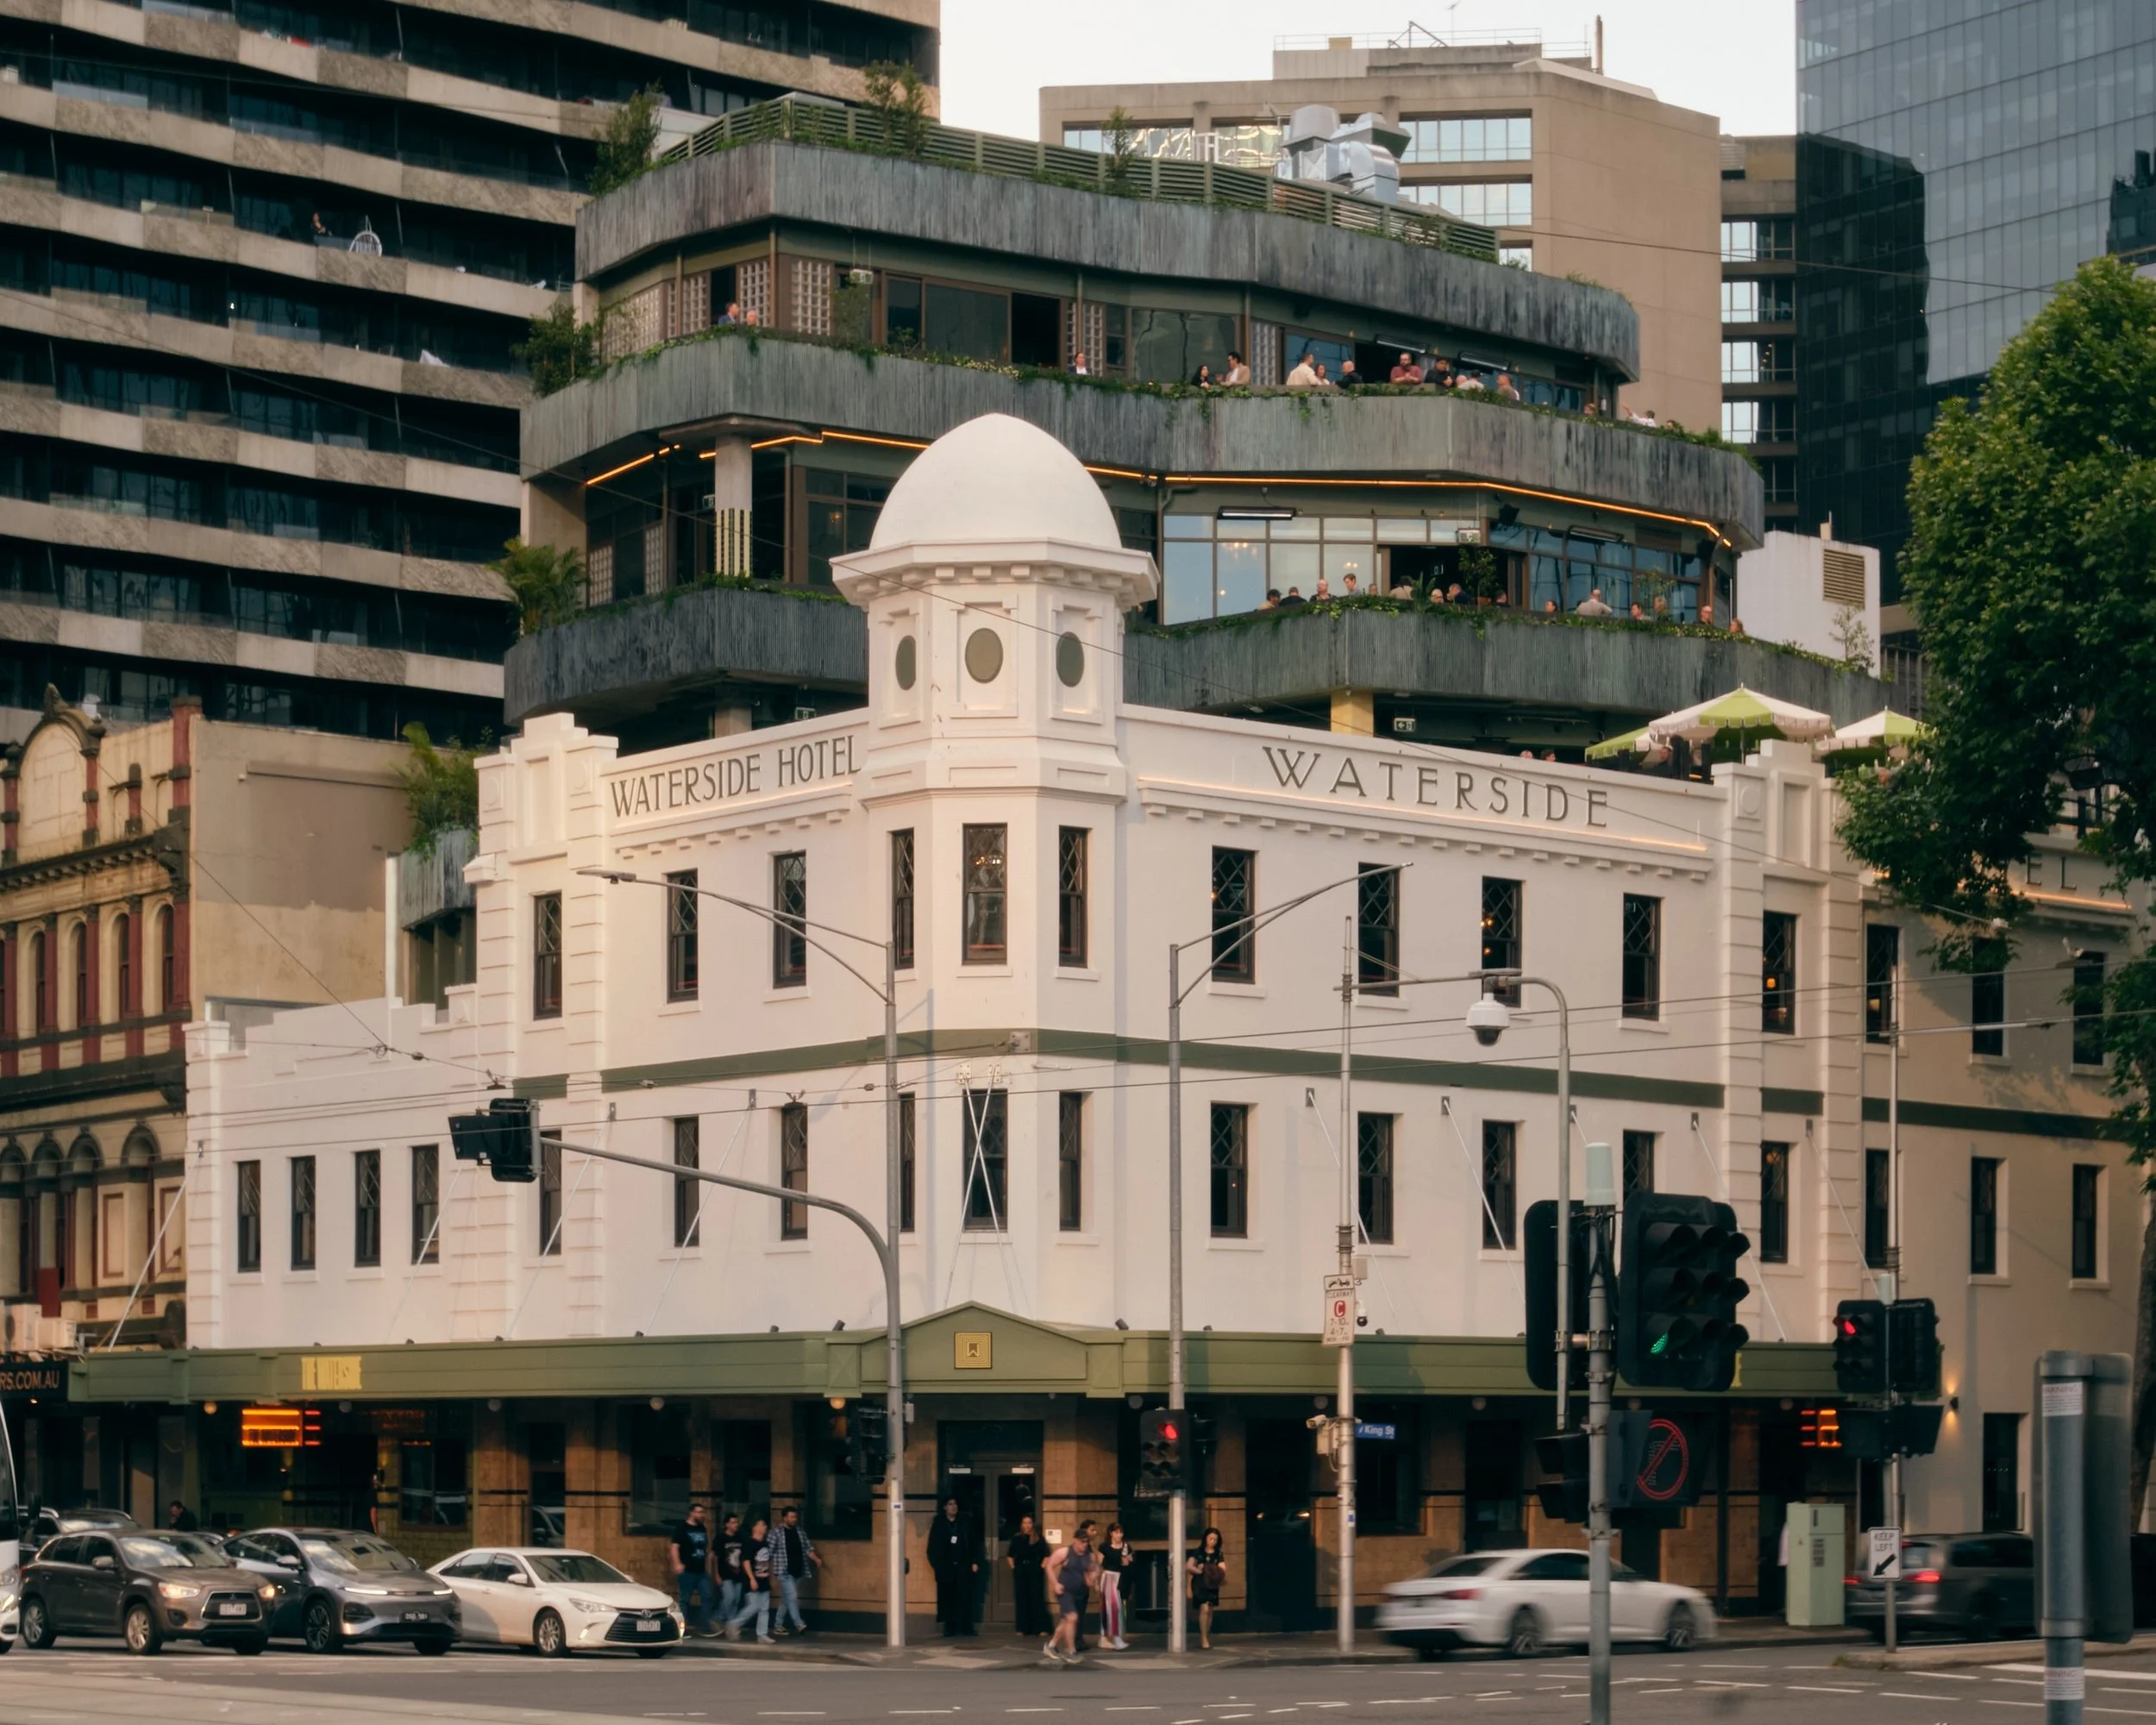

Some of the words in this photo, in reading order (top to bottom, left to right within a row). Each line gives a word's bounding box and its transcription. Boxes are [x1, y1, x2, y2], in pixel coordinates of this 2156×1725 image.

[611, 754, 761, 818] WATERSIDE
[778, 735, 861, 787] HOTEL
[1263, 746, 1608, 827] WATERSIDE
[1364, 1425, 1382, 1436] King
[1385, 1426, 1395, 1435] St
[1874, 1532, 1895, 1540] KEEP
[1876, 1542, 1893, 1552] LEFT
